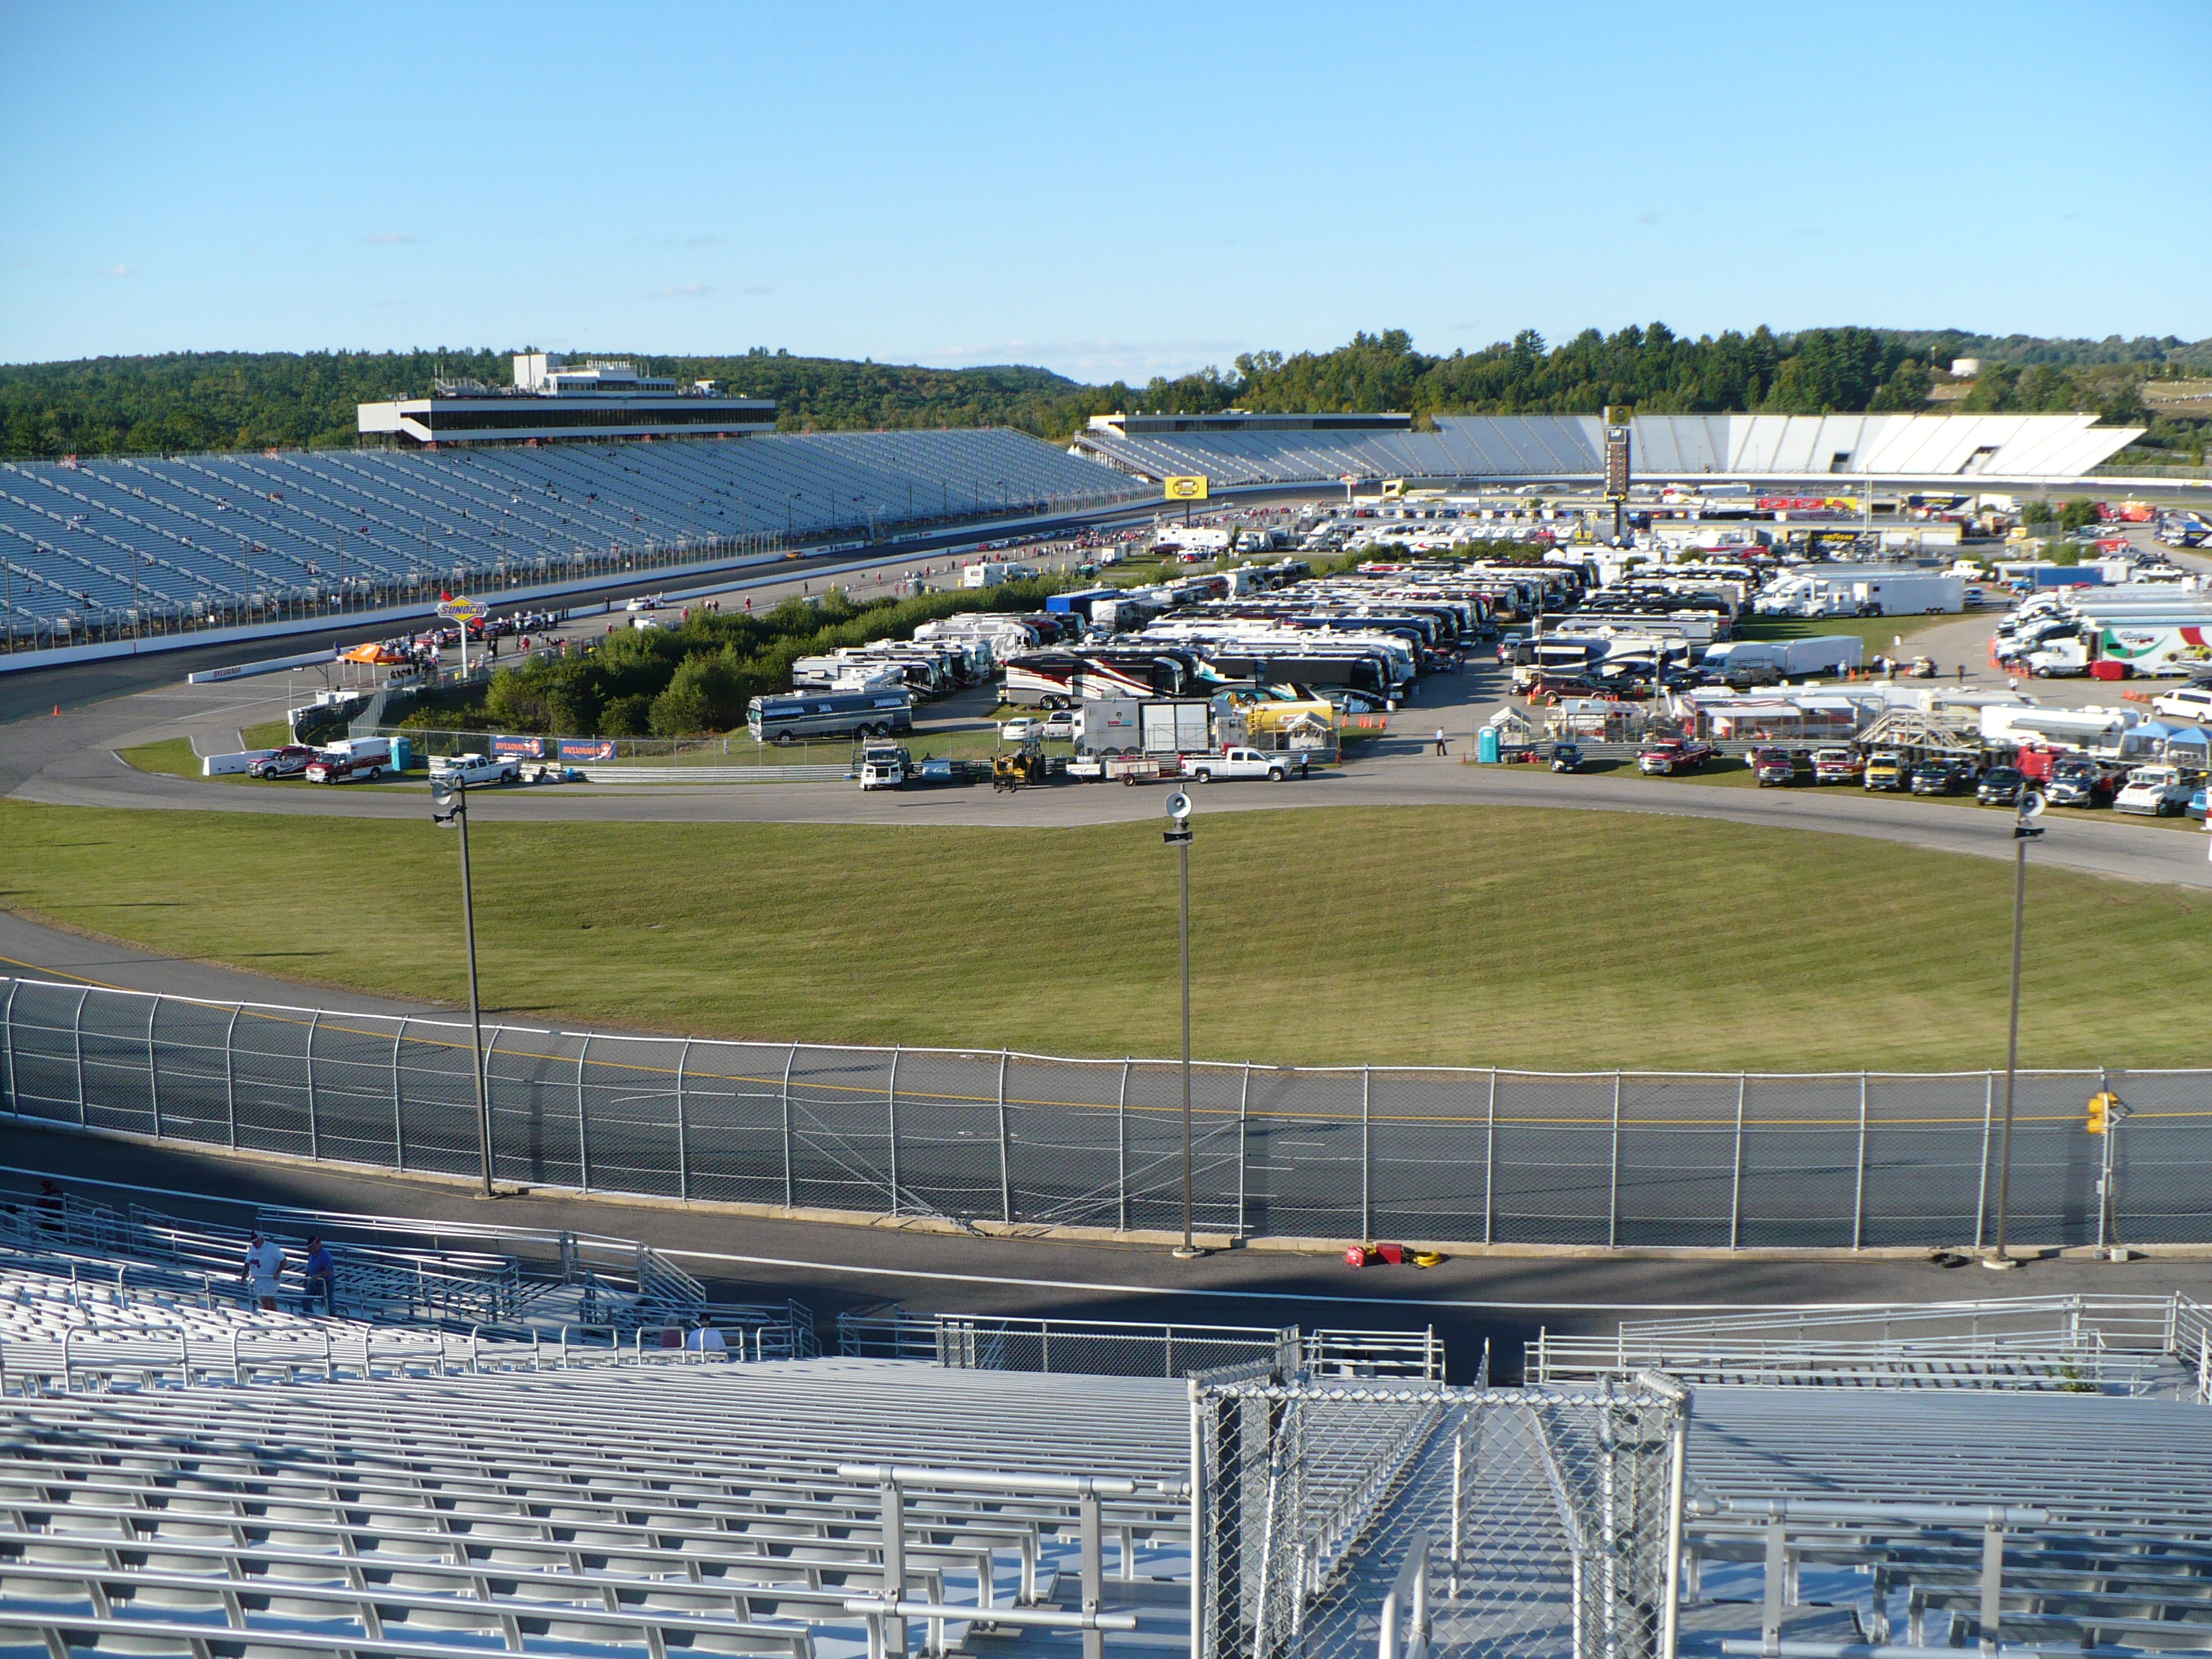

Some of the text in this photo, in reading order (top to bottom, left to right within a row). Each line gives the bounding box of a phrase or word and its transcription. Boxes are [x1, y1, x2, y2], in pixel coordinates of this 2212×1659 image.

[441, 606, 484, 614] SUNOCO
[213, 667, 241, 678] SYLVANIA
[495, 742, 531, 751] SYLVANA
